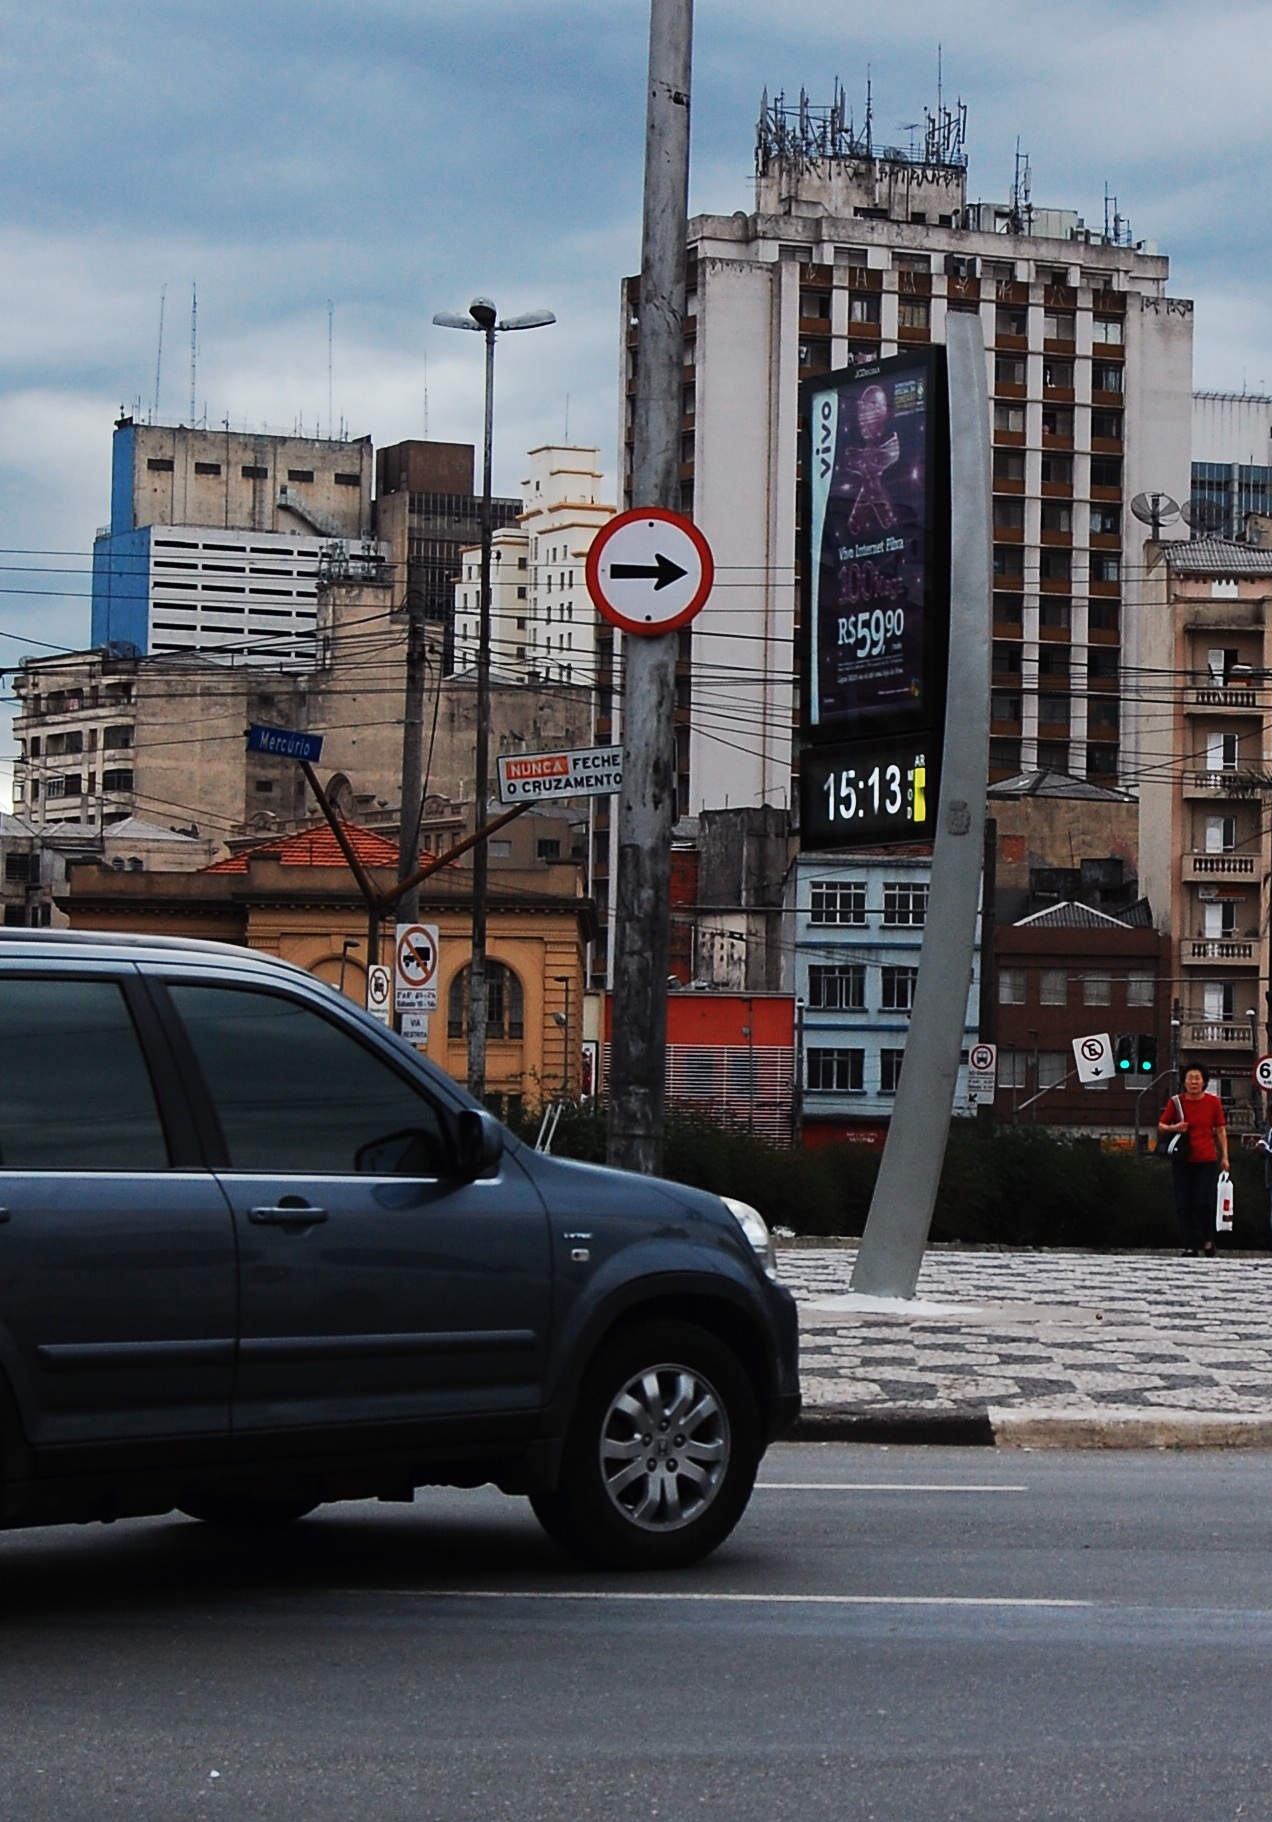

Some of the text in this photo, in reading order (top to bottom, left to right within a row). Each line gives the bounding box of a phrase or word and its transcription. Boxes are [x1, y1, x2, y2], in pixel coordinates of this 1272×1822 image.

[816, 401, 832, 479] vivo
[856, 541, 884, 557] Internet
[260, 731, 310, 755] Mercúrio
[511, 754, 620, 777] NUNCA FECHE
[507, 773, 623, 794] O CRUZAMENTO
[824, 764, 901, 821] 15:13
[411, 1019, 421, 1027] VIA
